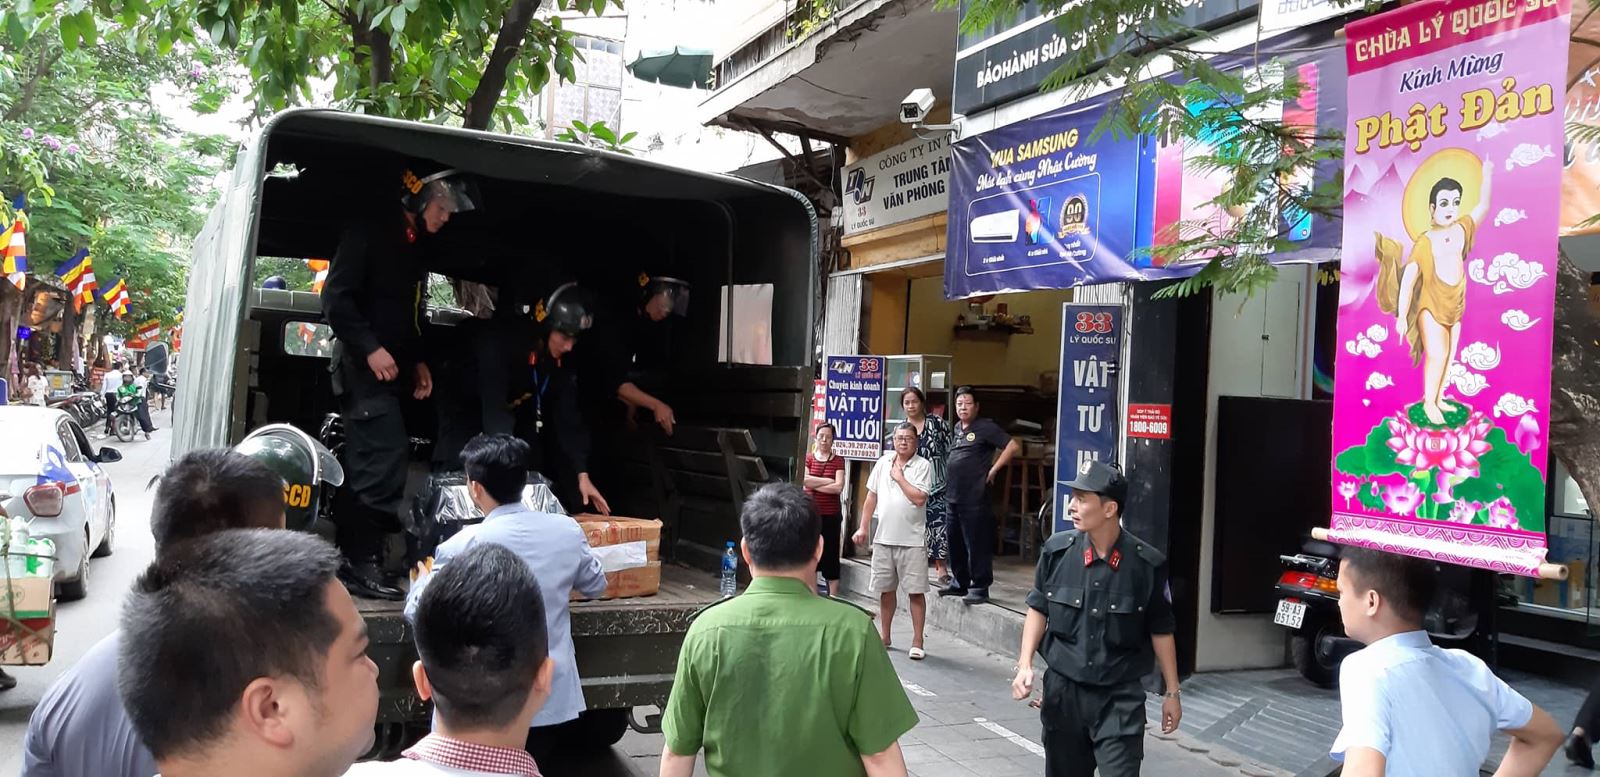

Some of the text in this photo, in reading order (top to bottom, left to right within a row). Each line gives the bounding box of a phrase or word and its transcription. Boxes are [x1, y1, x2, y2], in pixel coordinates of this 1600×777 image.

[1041, 33, 1068, 63] SỬA
[1355, 27, 1411, 62] CHÙA
[1419, 12, 1444, 44] LÝ
[1399, 51, 1504, 93] Kính Mừng
[1354, 103, 1448, 154] Phật
[1459, 77, 1554, 130] Đản
[878, 151, 908, 171] CÔNG
[910, 144, 924, 159] TY
[928, 137, 941, 152] IN
[1016, 128, 1078, 162] SAMSUNG
[893, 164, 929, 188] TRUNG
[1013, 169, 1036, 186] cùng
[1037, 158, 1063, 178] Nhật
[1064, 151, 1098, 172] Cường
[883, 179, 946, 210] VĂN PHÒNG
[1075, 312, 1113, 333] 33
[1081, 334, 1104, 345] QUỐC
[859, 358, 878, 371] 33
[1073, 354, 1111, 393] VẬT
[828, 380, 880, 391] Chuyên kinh doanh
[828, 392, 857, 417] VẬT
[860, 396, 880, 413] TƯ
[1077, 403, 1105, 433] TƯ
[846, 415, 880, 440] LƯỚI
[1130, 421, 1167, 434] 1800-6009
[1276, 612, 1301, 627] 051.52
[1281, 602, 1301, 615] 59-A3
